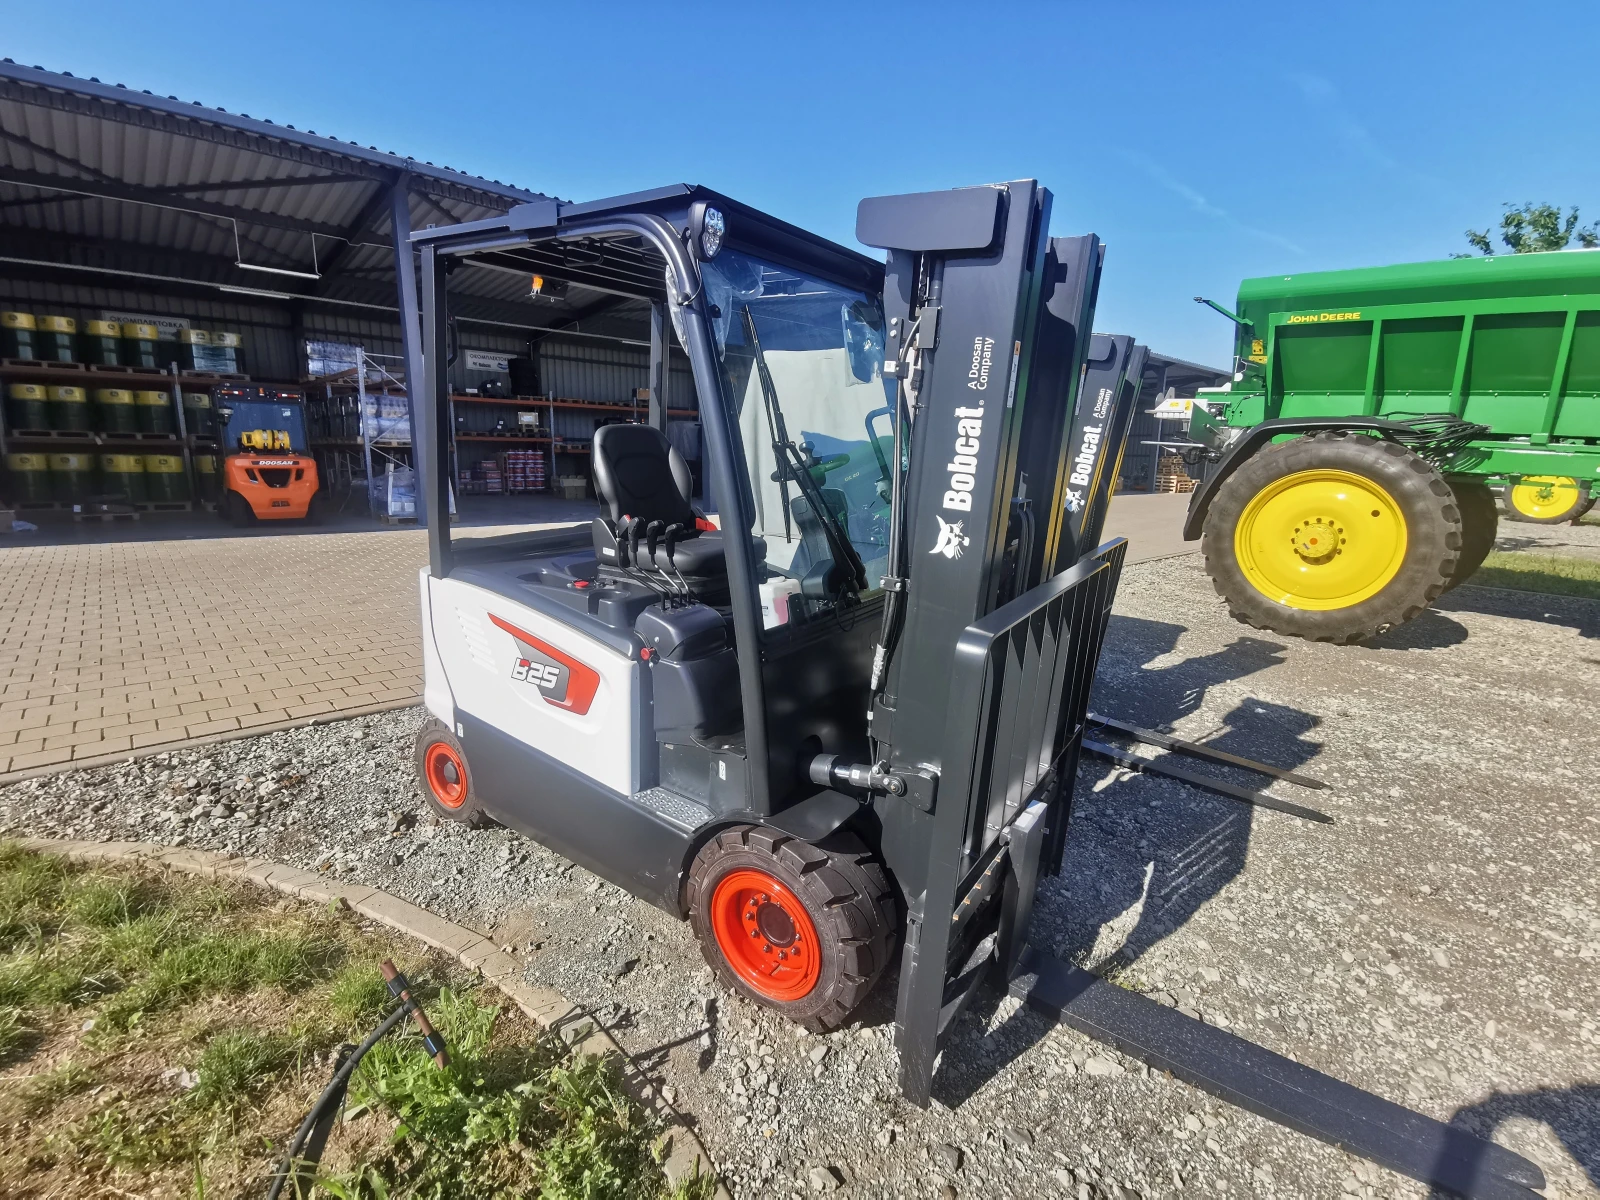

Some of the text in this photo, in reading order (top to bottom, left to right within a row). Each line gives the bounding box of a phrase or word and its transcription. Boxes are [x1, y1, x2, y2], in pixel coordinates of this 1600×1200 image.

[1287, 312, 1361, 324] JOHN DEERE
[968, 336, 983, 390] A Doosan
[977, 337, 995, 390] Company
[1094, 388, 1106, 413] Doosan
[1099, 389, 1113, 419] Company
[1070, 426, 1102, 486] Bobcat
[511, 657, 560, 689] B25
